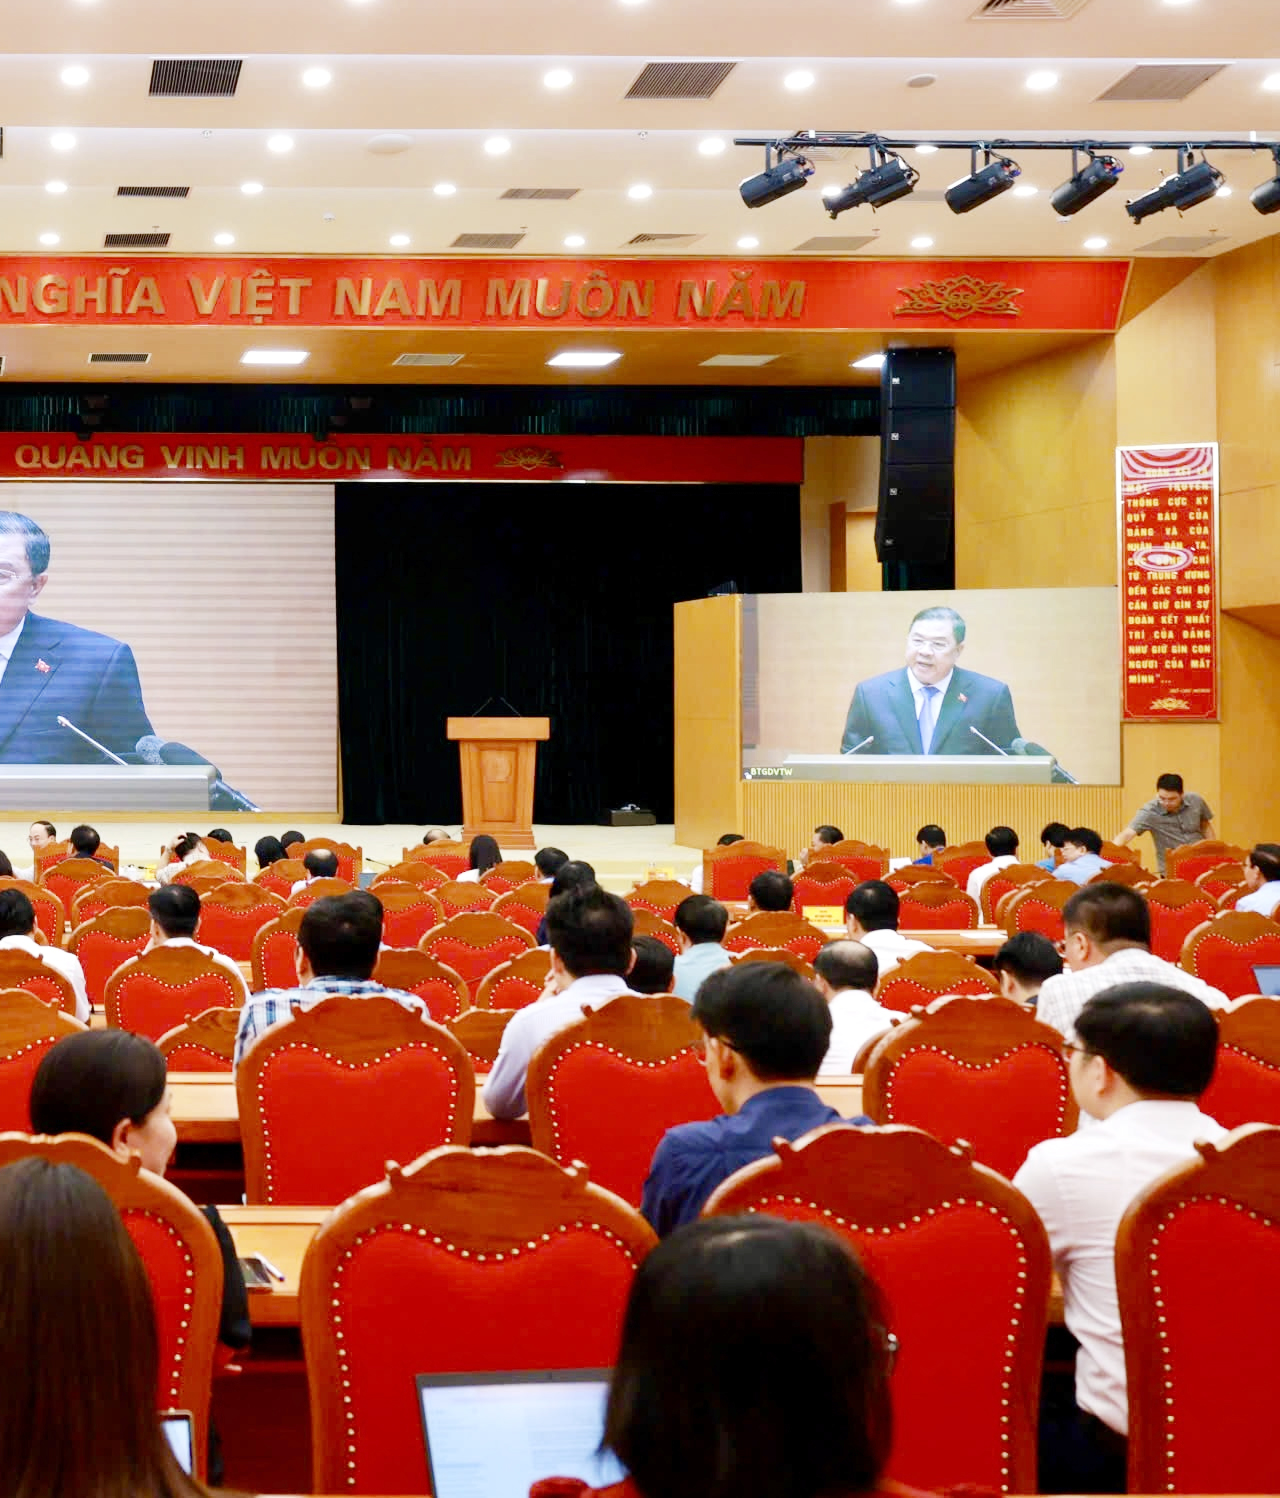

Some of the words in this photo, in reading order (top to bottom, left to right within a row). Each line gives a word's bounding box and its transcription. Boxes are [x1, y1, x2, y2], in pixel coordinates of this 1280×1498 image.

[188, 270, 313, 323] VIỆT
[334, 278, 461, 317] NAM
[486, 271, 651, 318] MUÔN
[677, 270, 806, 318] NĂM
[15, 444, 144, 469] QUANG
[161, 446, 245, 470] VINH
[260, 439, 372, 470] MUÔN
[386, 439, 471, 470] NĂM
[1192, 645, 1210, 653] CON
